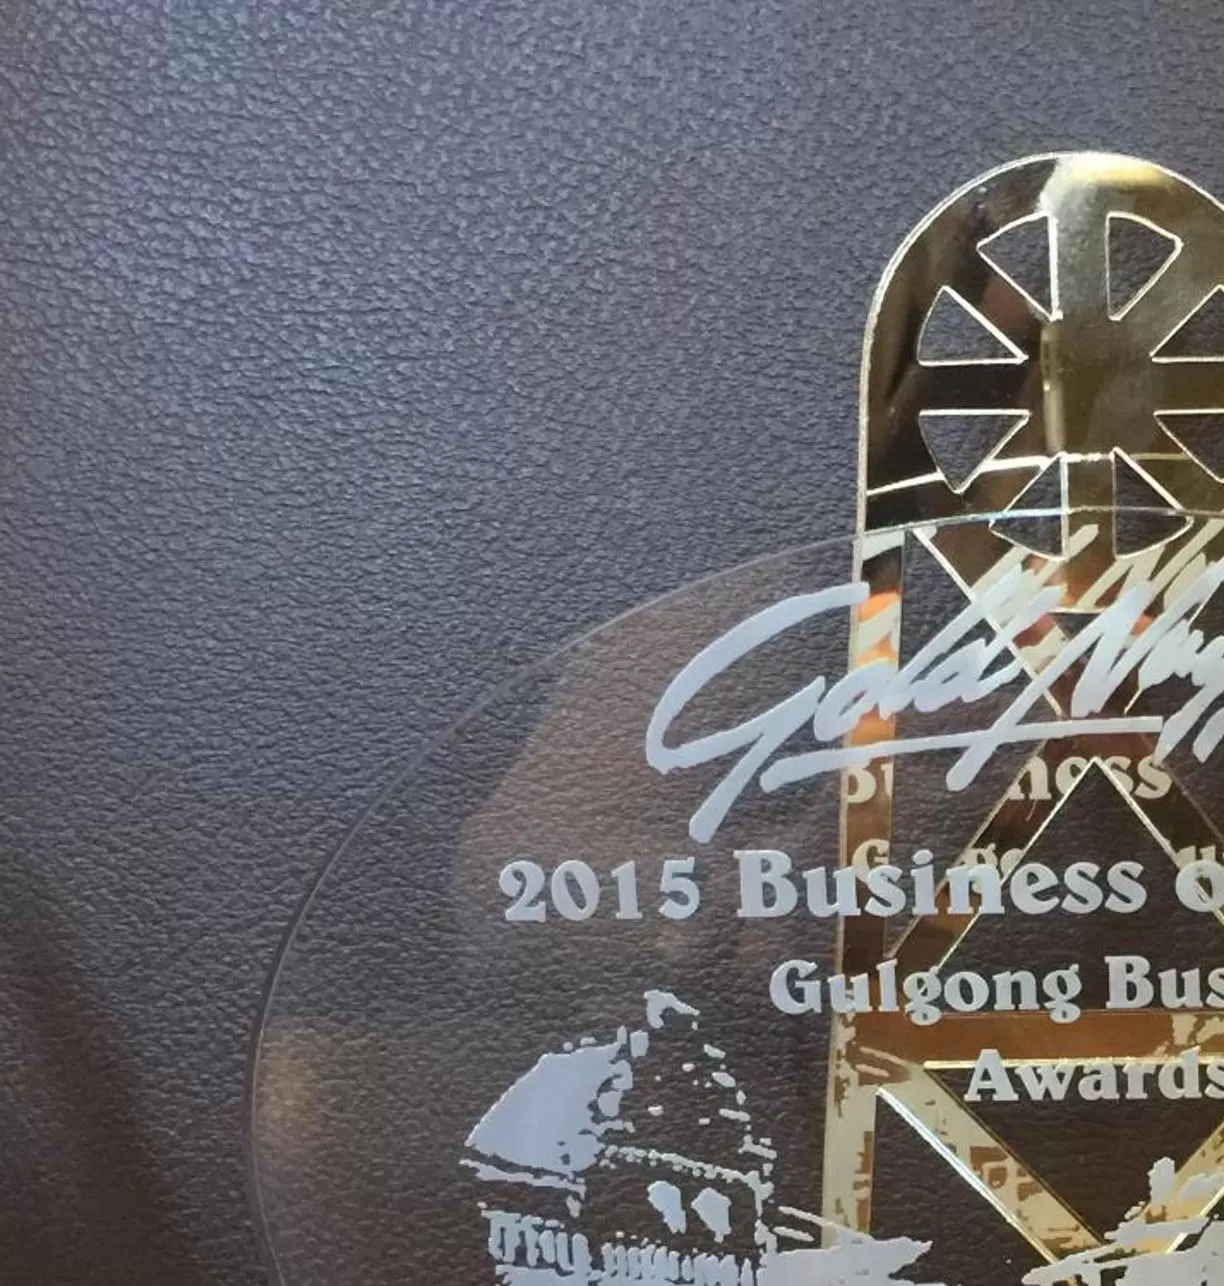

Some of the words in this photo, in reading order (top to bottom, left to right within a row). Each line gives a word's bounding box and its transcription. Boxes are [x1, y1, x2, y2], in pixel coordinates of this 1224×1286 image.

[499, 856, 701, 923] 2015
[733, 849, 1147, 919] Business
[769, 958, 1082, 1026] Gulgong
